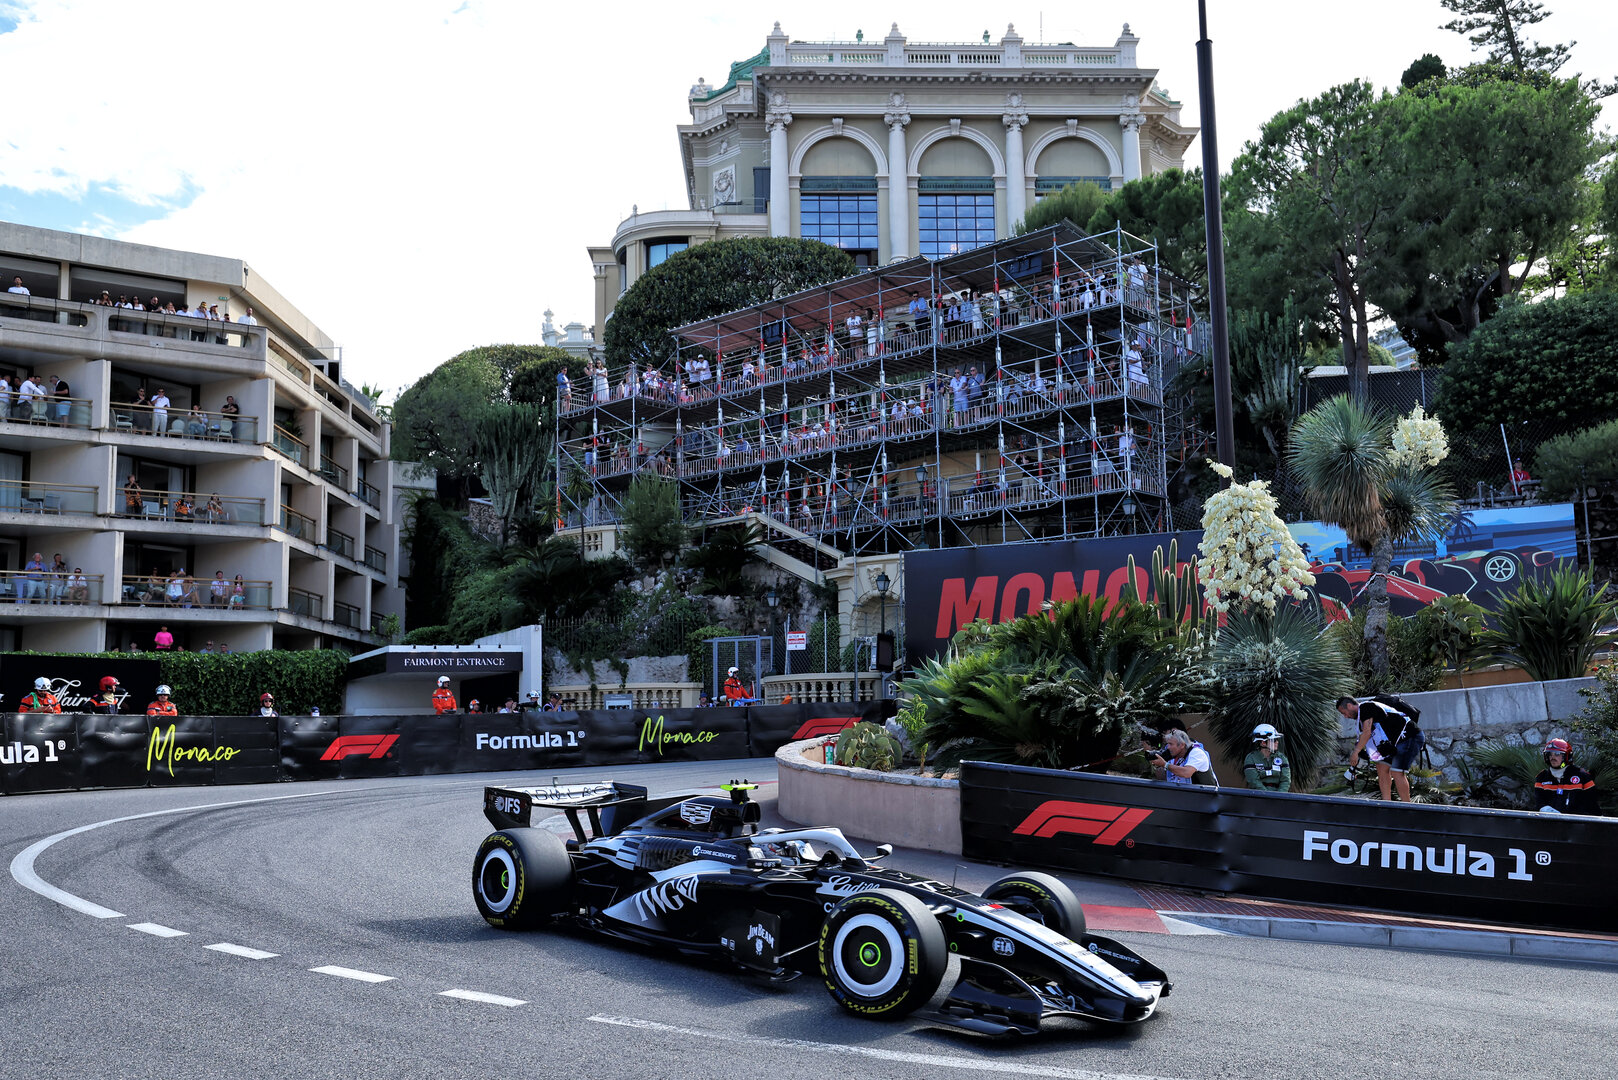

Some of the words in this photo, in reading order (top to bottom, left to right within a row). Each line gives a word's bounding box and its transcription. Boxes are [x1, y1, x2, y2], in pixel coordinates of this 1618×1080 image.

[404, 658, 454, 666] FAIRMONT
[456, 657, 505, 666] ENTRANCE
[49, 677, 131, 709] Fairt
[476, 732, 563, 749] Formula
[638, 715, 719, 755] Monaco
[147, 724, 241, 777] Monaco
[504, 797, 521, 814] IFS
[487, 834, 514, 847] ZERO
[712, 851, 737, 860] SCIENTIFIC
[1303, 830, 1495, 878] Formula
[819, 924, 829, 977] ZERO
[908, 938, 918, 975] PIRELLI
[1097, 947, 1113, 957] CORE
[1112, 952, 1141, 965] SCIENTIFIC
